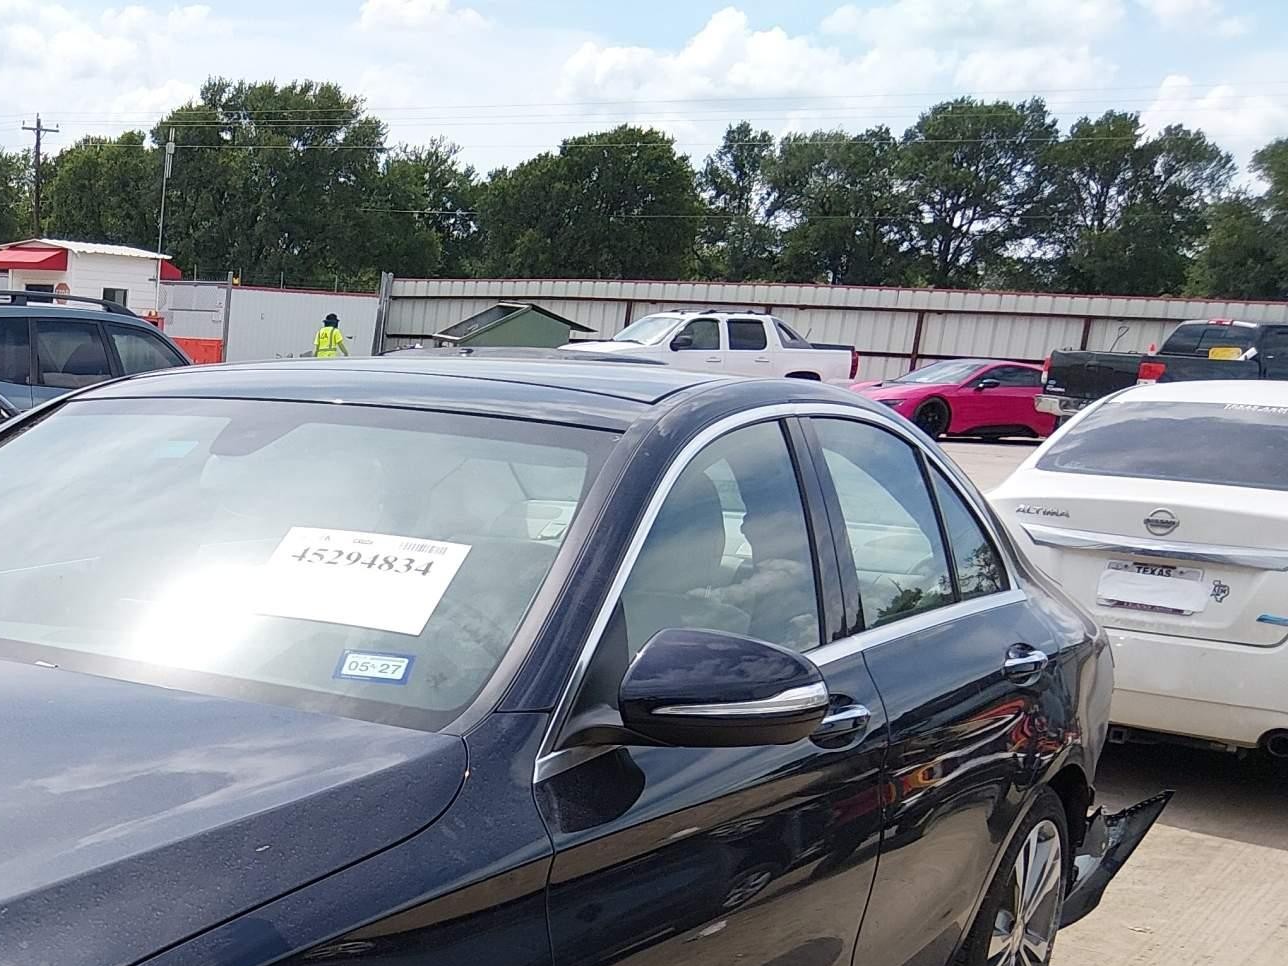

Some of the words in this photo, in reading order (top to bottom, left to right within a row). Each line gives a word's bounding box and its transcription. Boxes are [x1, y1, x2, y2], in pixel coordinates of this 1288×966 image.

[1016, 504, 1070, 518] ALTIMA
[291, 546, 434, 577] 45294834
[1135, 566, 1172, 577] TEXAS
